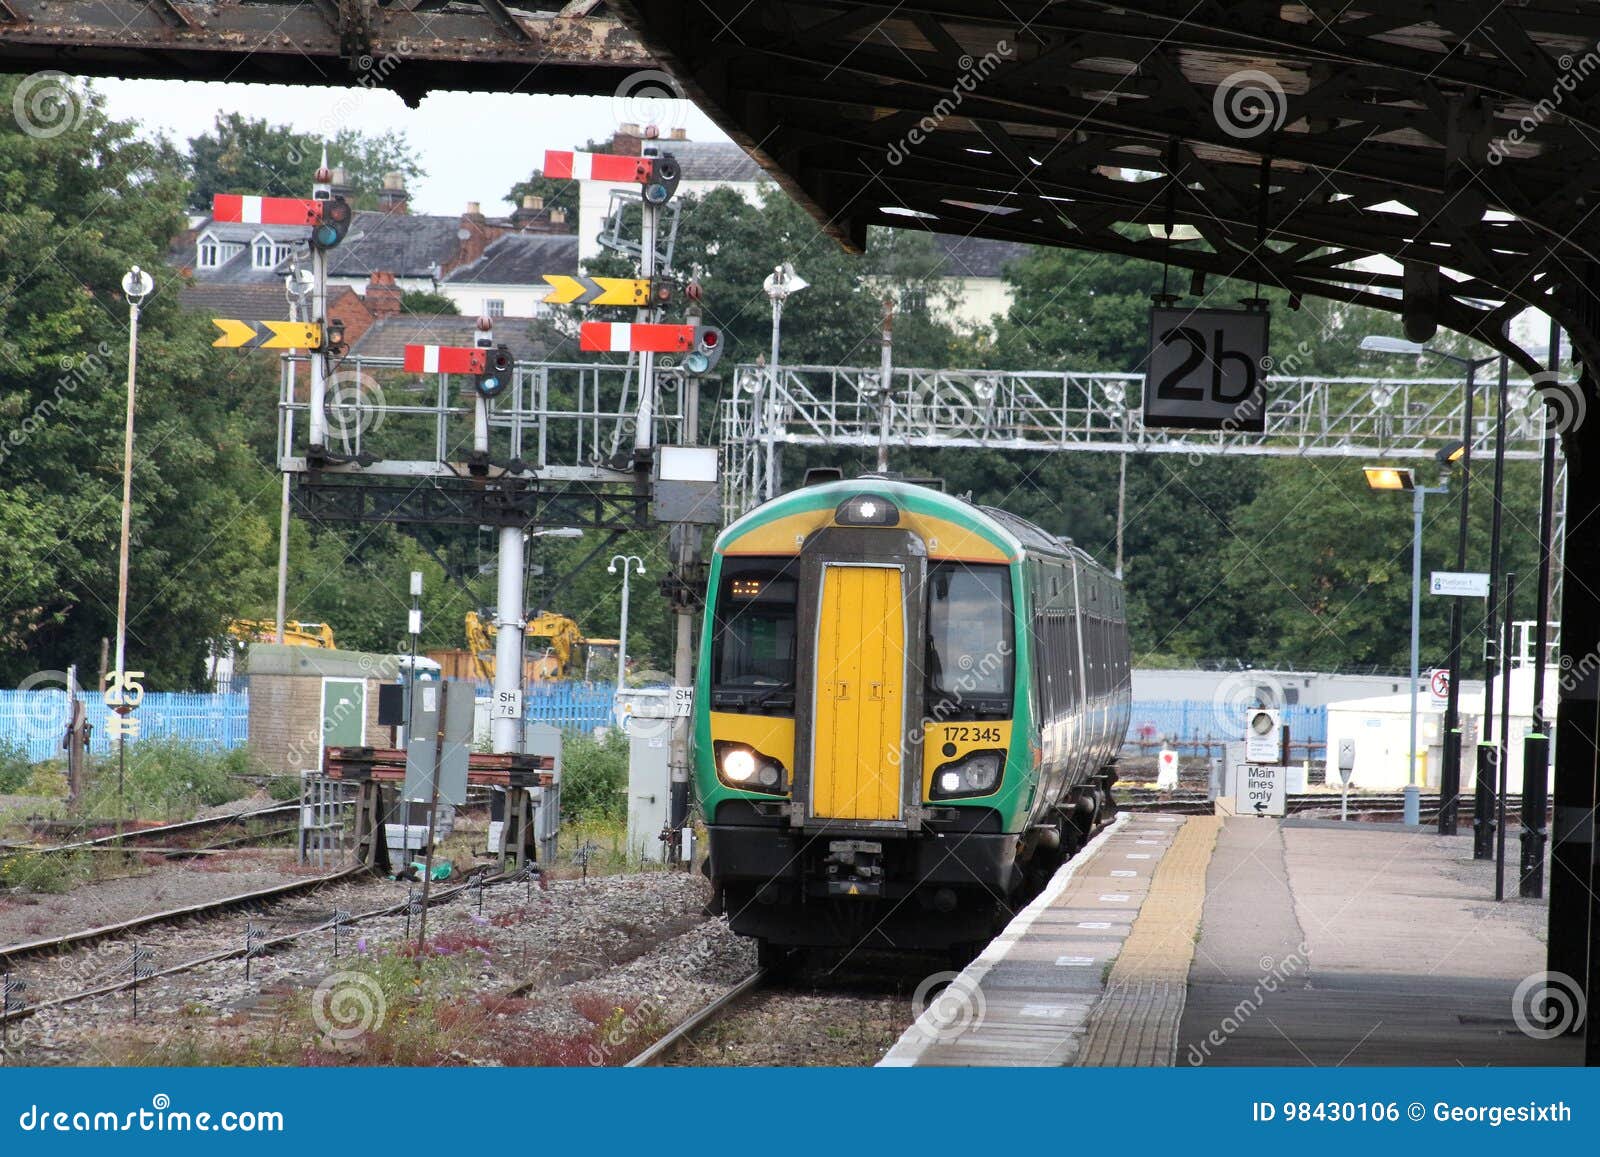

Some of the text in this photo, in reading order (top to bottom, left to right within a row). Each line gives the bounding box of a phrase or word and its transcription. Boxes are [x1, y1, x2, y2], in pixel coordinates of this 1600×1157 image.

[1157, 326, 1257, 404] 2b
[104, 670, 145, 706] 25
[499, 692, 516, 702] SH
[675, 689, 692, 700] SH
[500, 705, 514, 715] 78
[676, 703, 691, 713] 77
[943, 727, 1001, 742] 172 345
[1248, 767, 1275, 778] Main
[1248, 779, 1274, 789] lines
[1248, 790, 1272, 802] only
